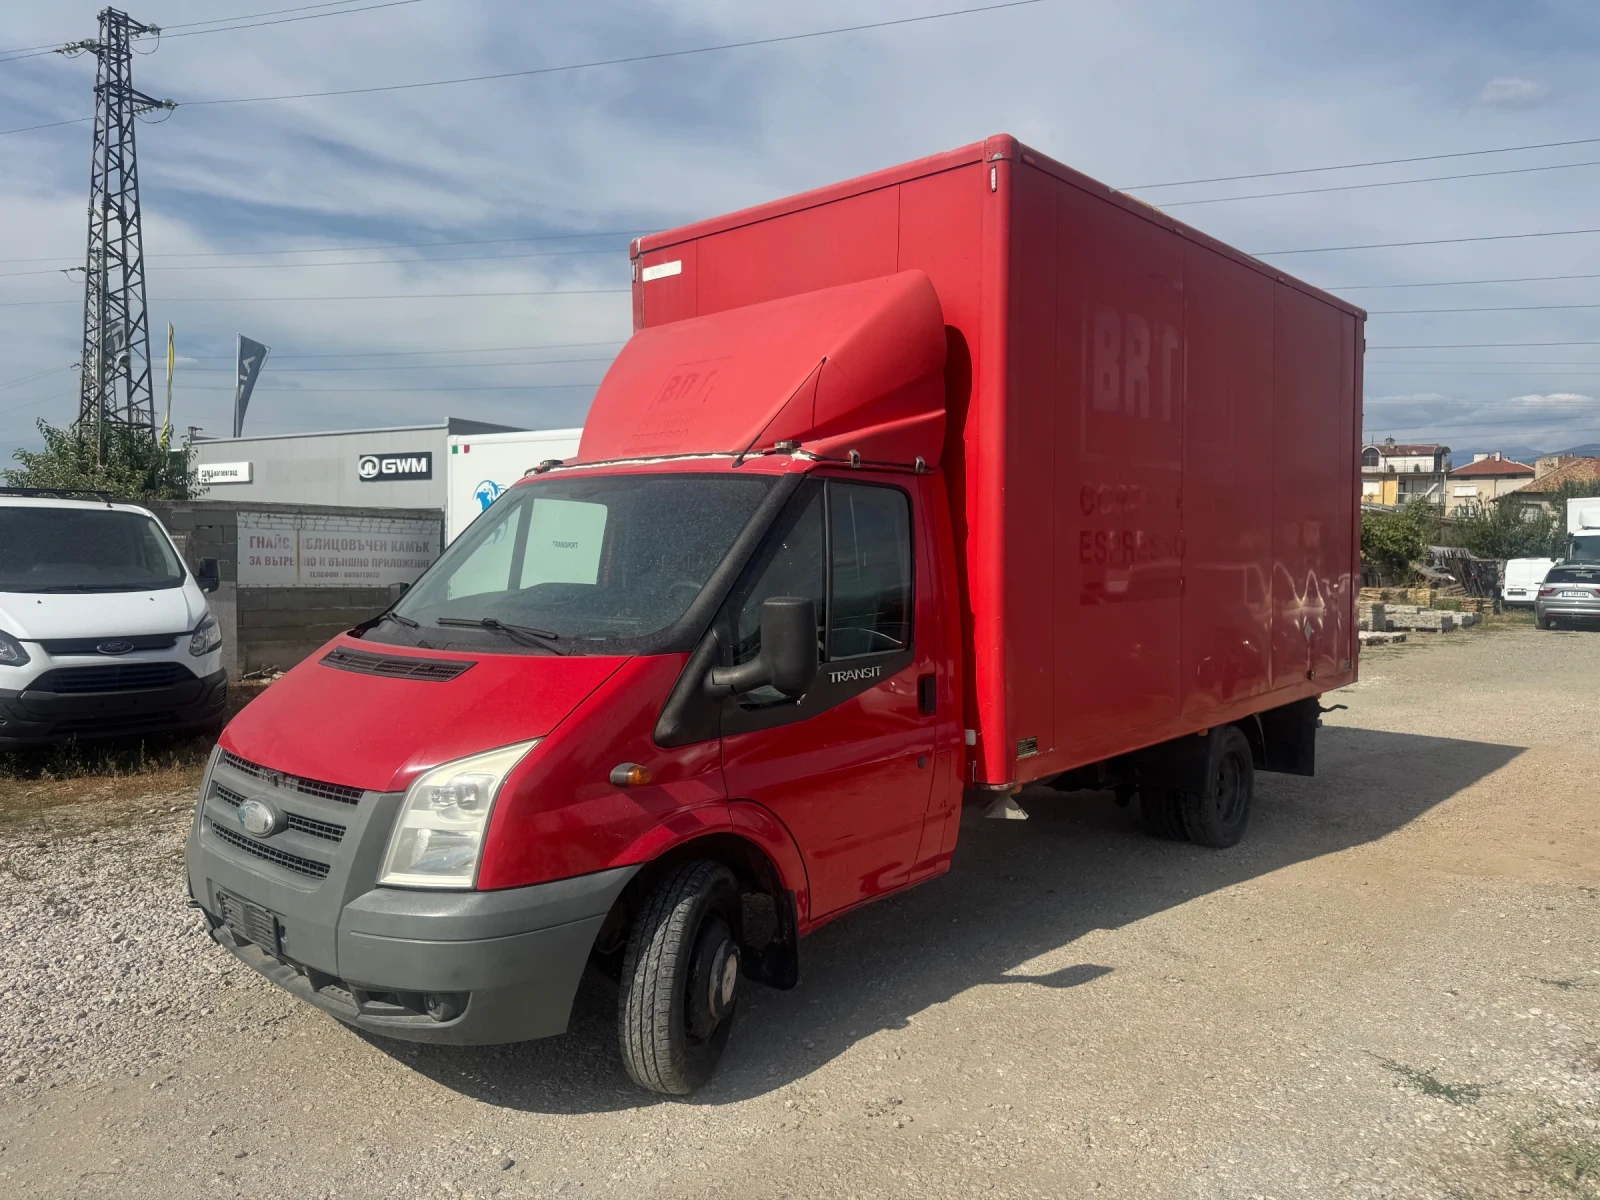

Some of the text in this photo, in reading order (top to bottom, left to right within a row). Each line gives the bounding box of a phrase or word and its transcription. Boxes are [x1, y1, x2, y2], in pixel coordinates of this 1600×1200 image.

[381, 457, 427, 473] GWM
[391, 541, 430, 553] КАМЪК
[552, 540, 579, 549] TRANSPORT
[249, 556, 262, 566] ЗА
[265, 556, 316, 567] ВЪТРЕНО
[319, 557, 326, 567] И
[328, 557, 369, 568] ВЪНШНО
[828, 665, 882, 683] TRANSIT
